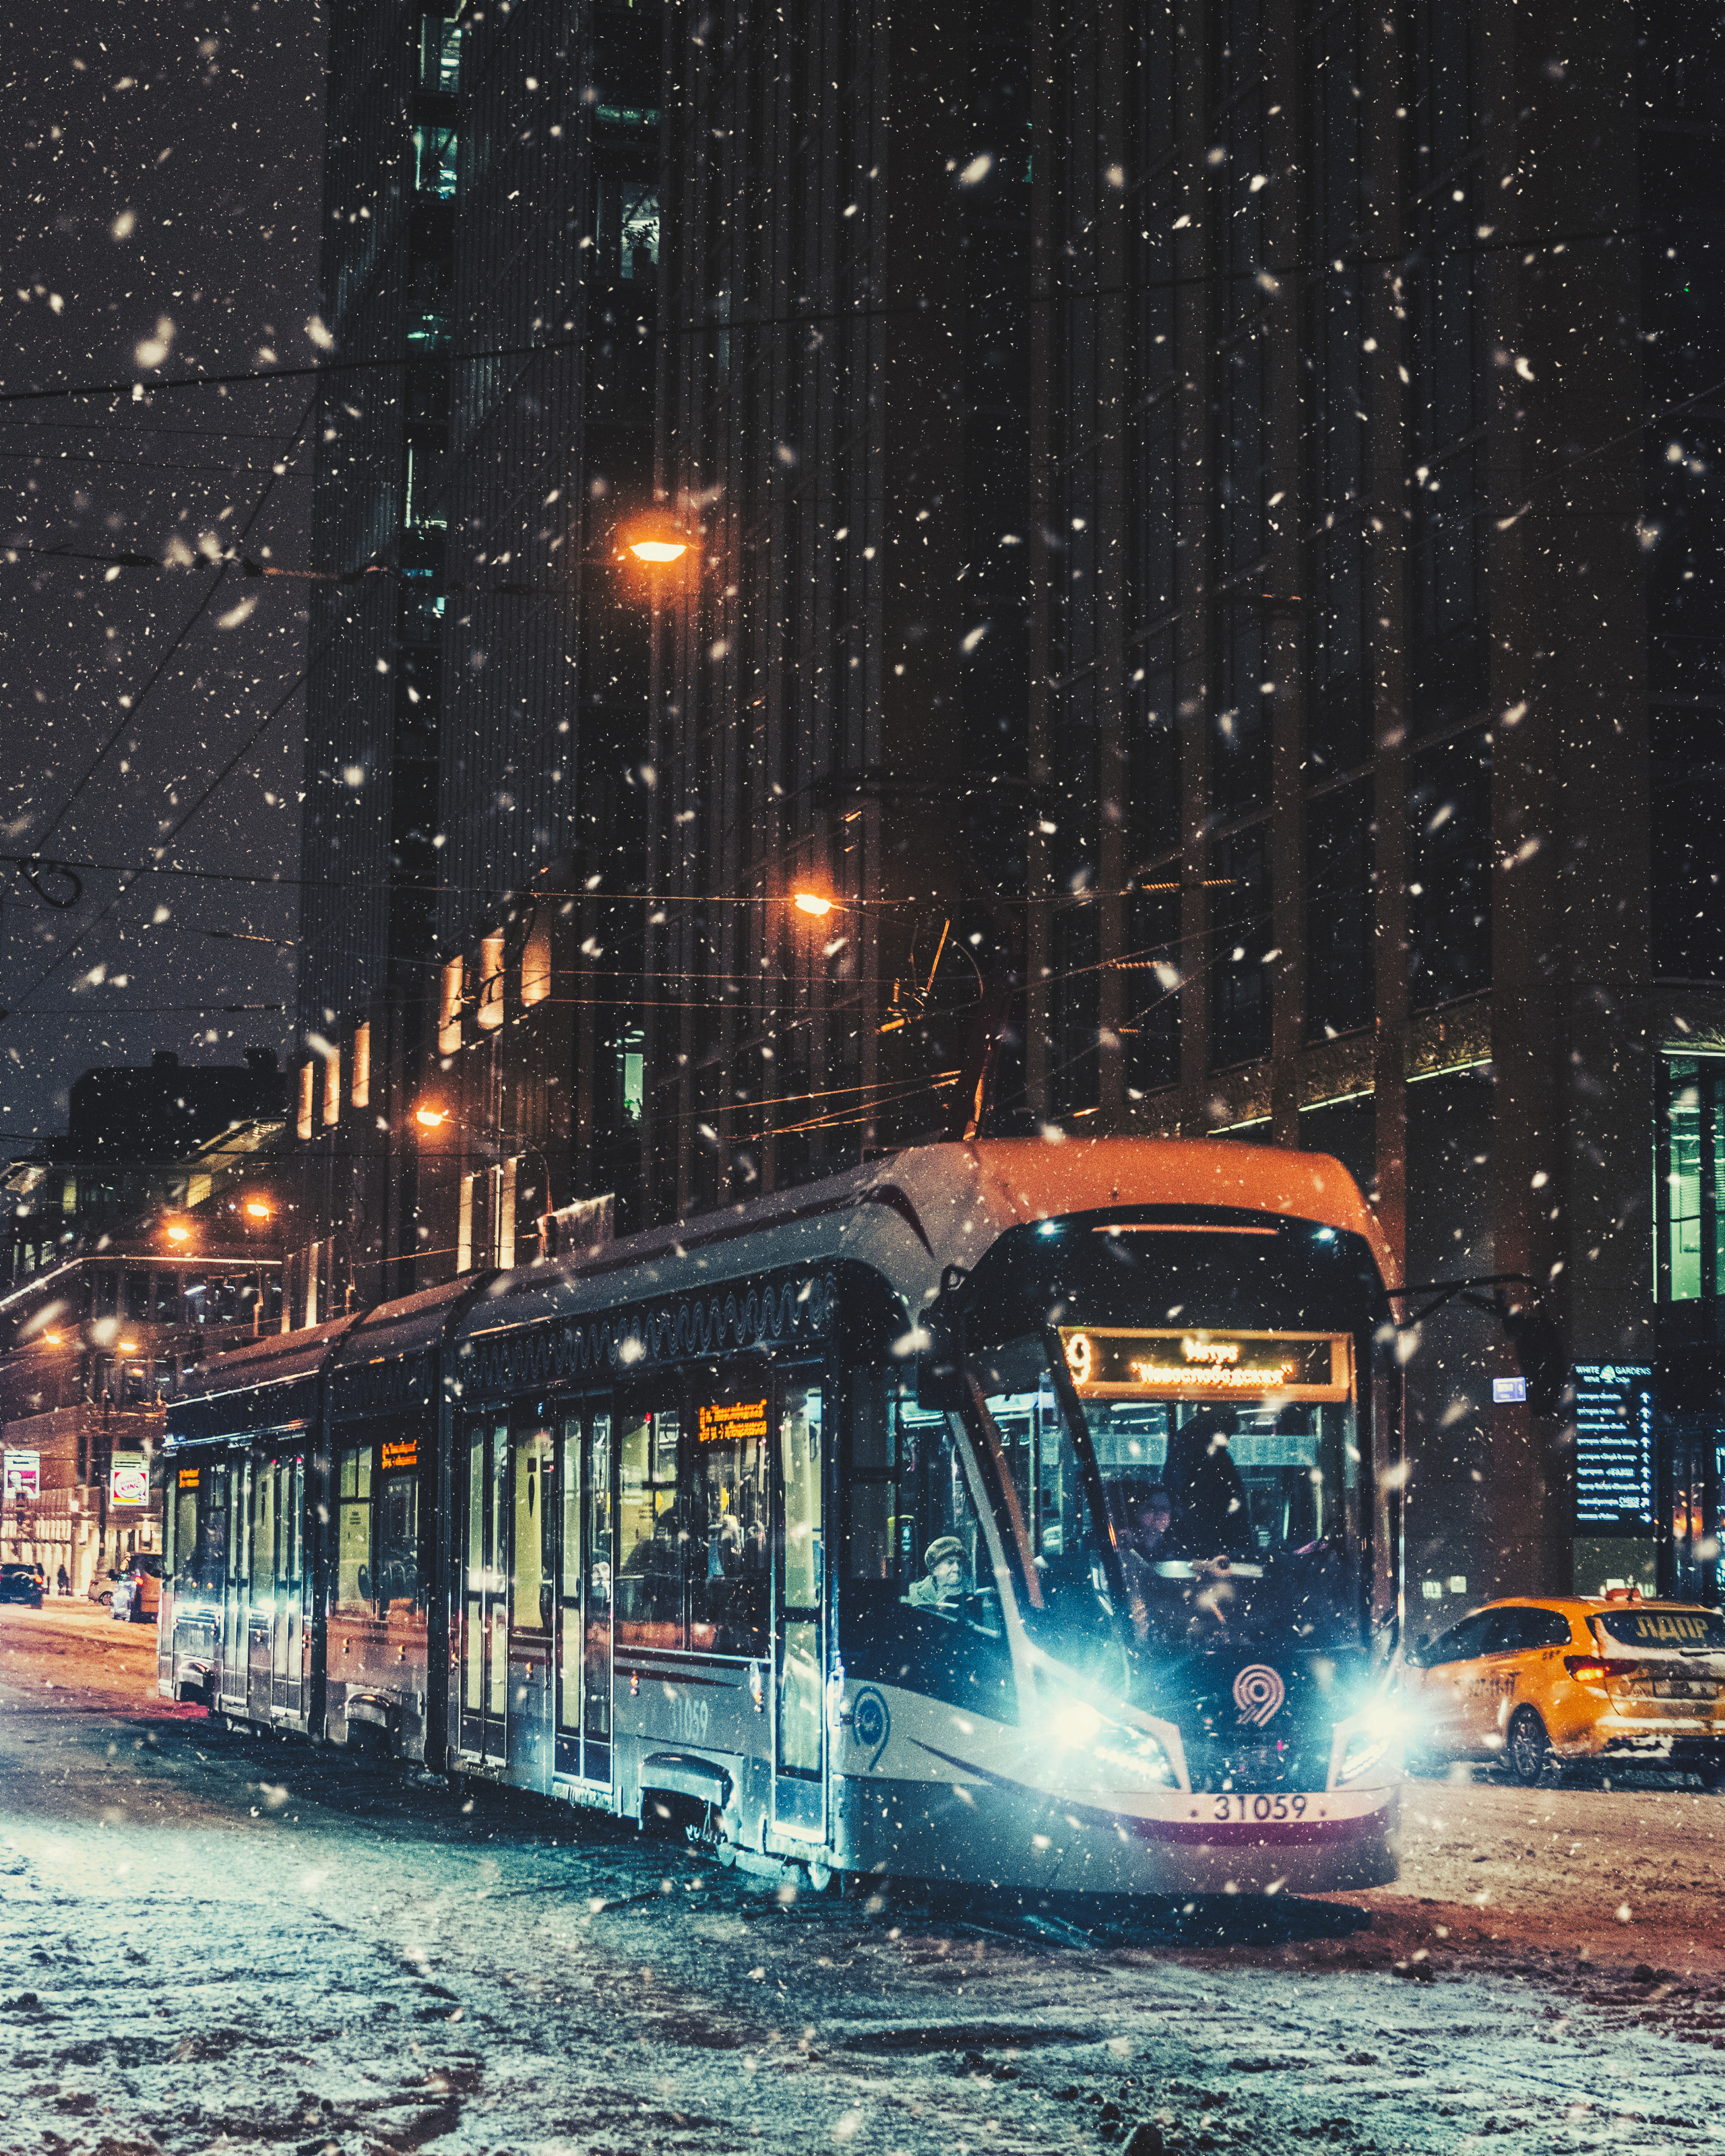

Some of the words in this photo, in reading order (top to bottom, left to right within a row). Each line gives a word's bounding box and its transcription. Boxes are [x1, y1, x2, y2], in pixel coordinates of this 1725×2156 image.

[1067, 1333, 1091, 1385] 9
[1185, 1341, 1238, 1364] Метро
[1575, 1366, 1600, 1374] WHITE
[1615, 1366, 1652, 1376] GARDENS
[1635, 1616, 1709, 1643] ЛДПР
[1214, 1795, 1307, 1821] 31059
